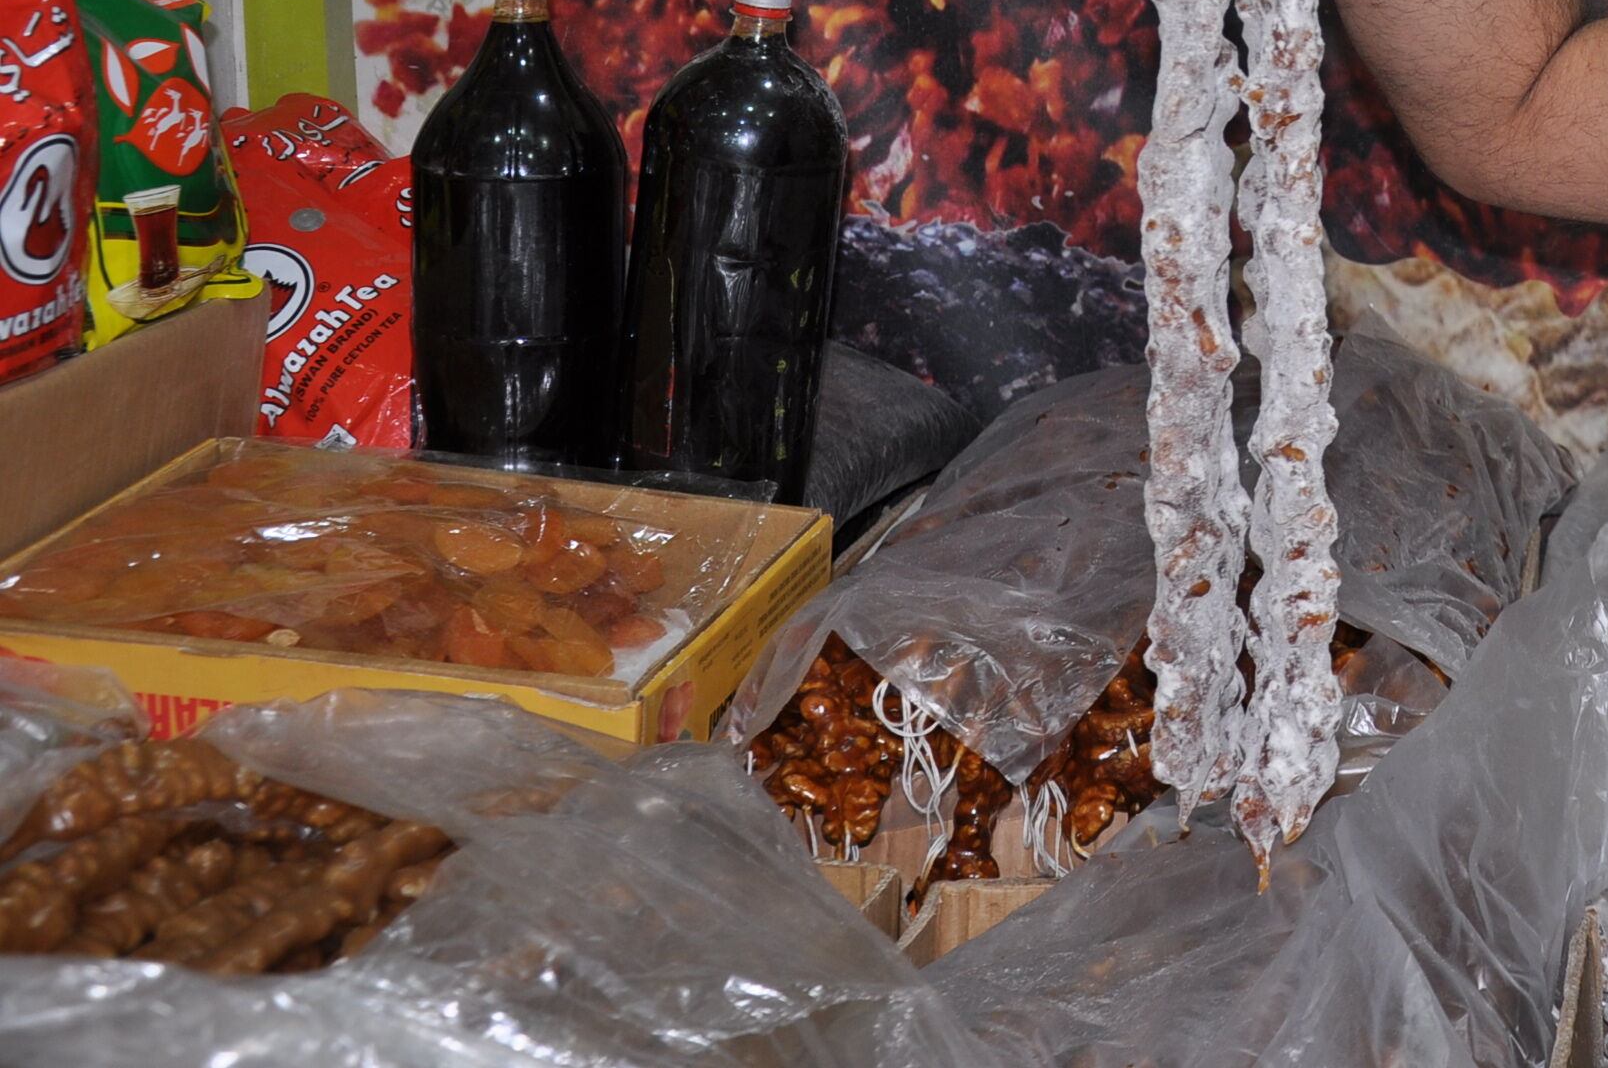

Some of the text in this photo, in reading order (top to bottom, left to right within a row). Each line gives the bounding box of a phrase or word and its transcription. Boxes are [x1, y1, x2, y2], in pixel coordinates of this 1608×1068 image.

[260, 273, 400, 429] Alwazah Tea
[321, 366, 346, 396] PURE
[342, 328, 384, 366] CEYLON
[380, 311, 404, 330] TEA
[327, 307, 379, 354] BRAND)
